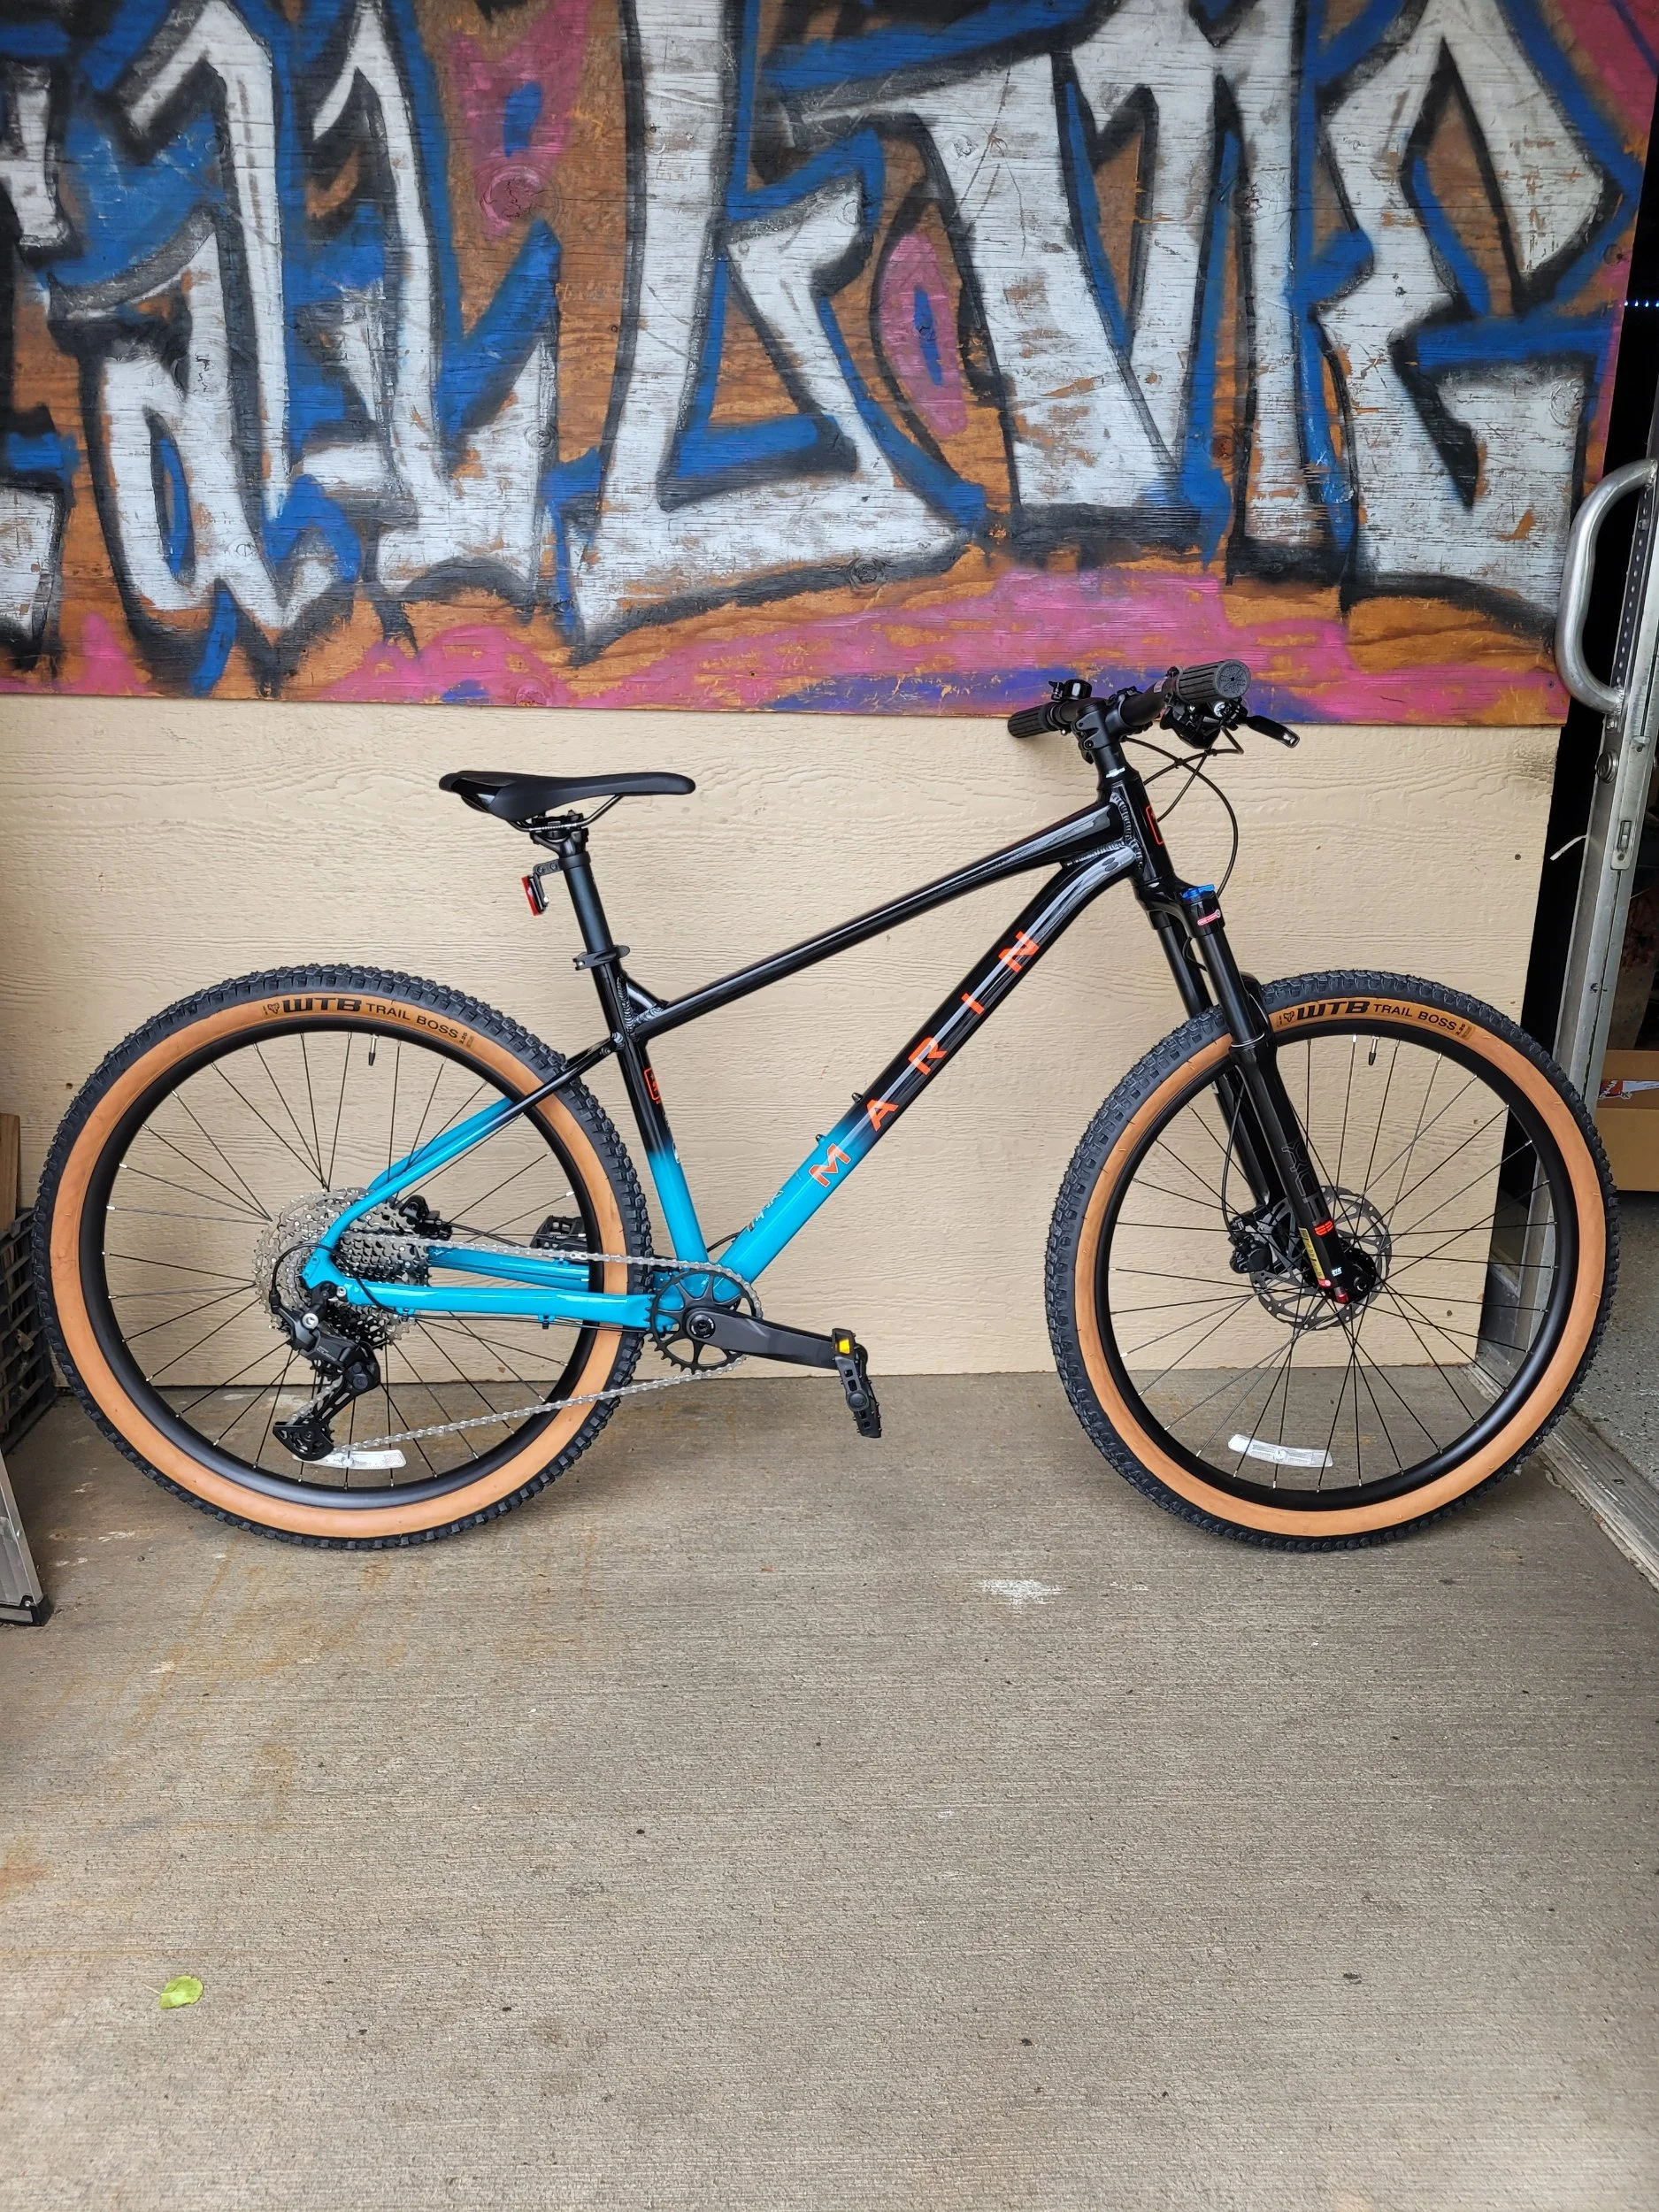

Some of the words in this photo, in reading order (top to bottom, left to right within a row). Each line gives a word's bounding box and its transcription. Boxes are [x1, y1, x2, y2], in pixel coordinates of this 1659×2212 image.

[282, 997, 362, 1013] WTB
[366, 1003, 411, 1021] TRAIL
[417, 1016, 459, 1039] BOSS
[1296, 1001, 1371, 1021] WTB
[1373, 1003, 1413, 1018] TRAIL
[1417, 1010, 1458, 1032] BOSS
[808, 930, 1040, 1188] MARIN
